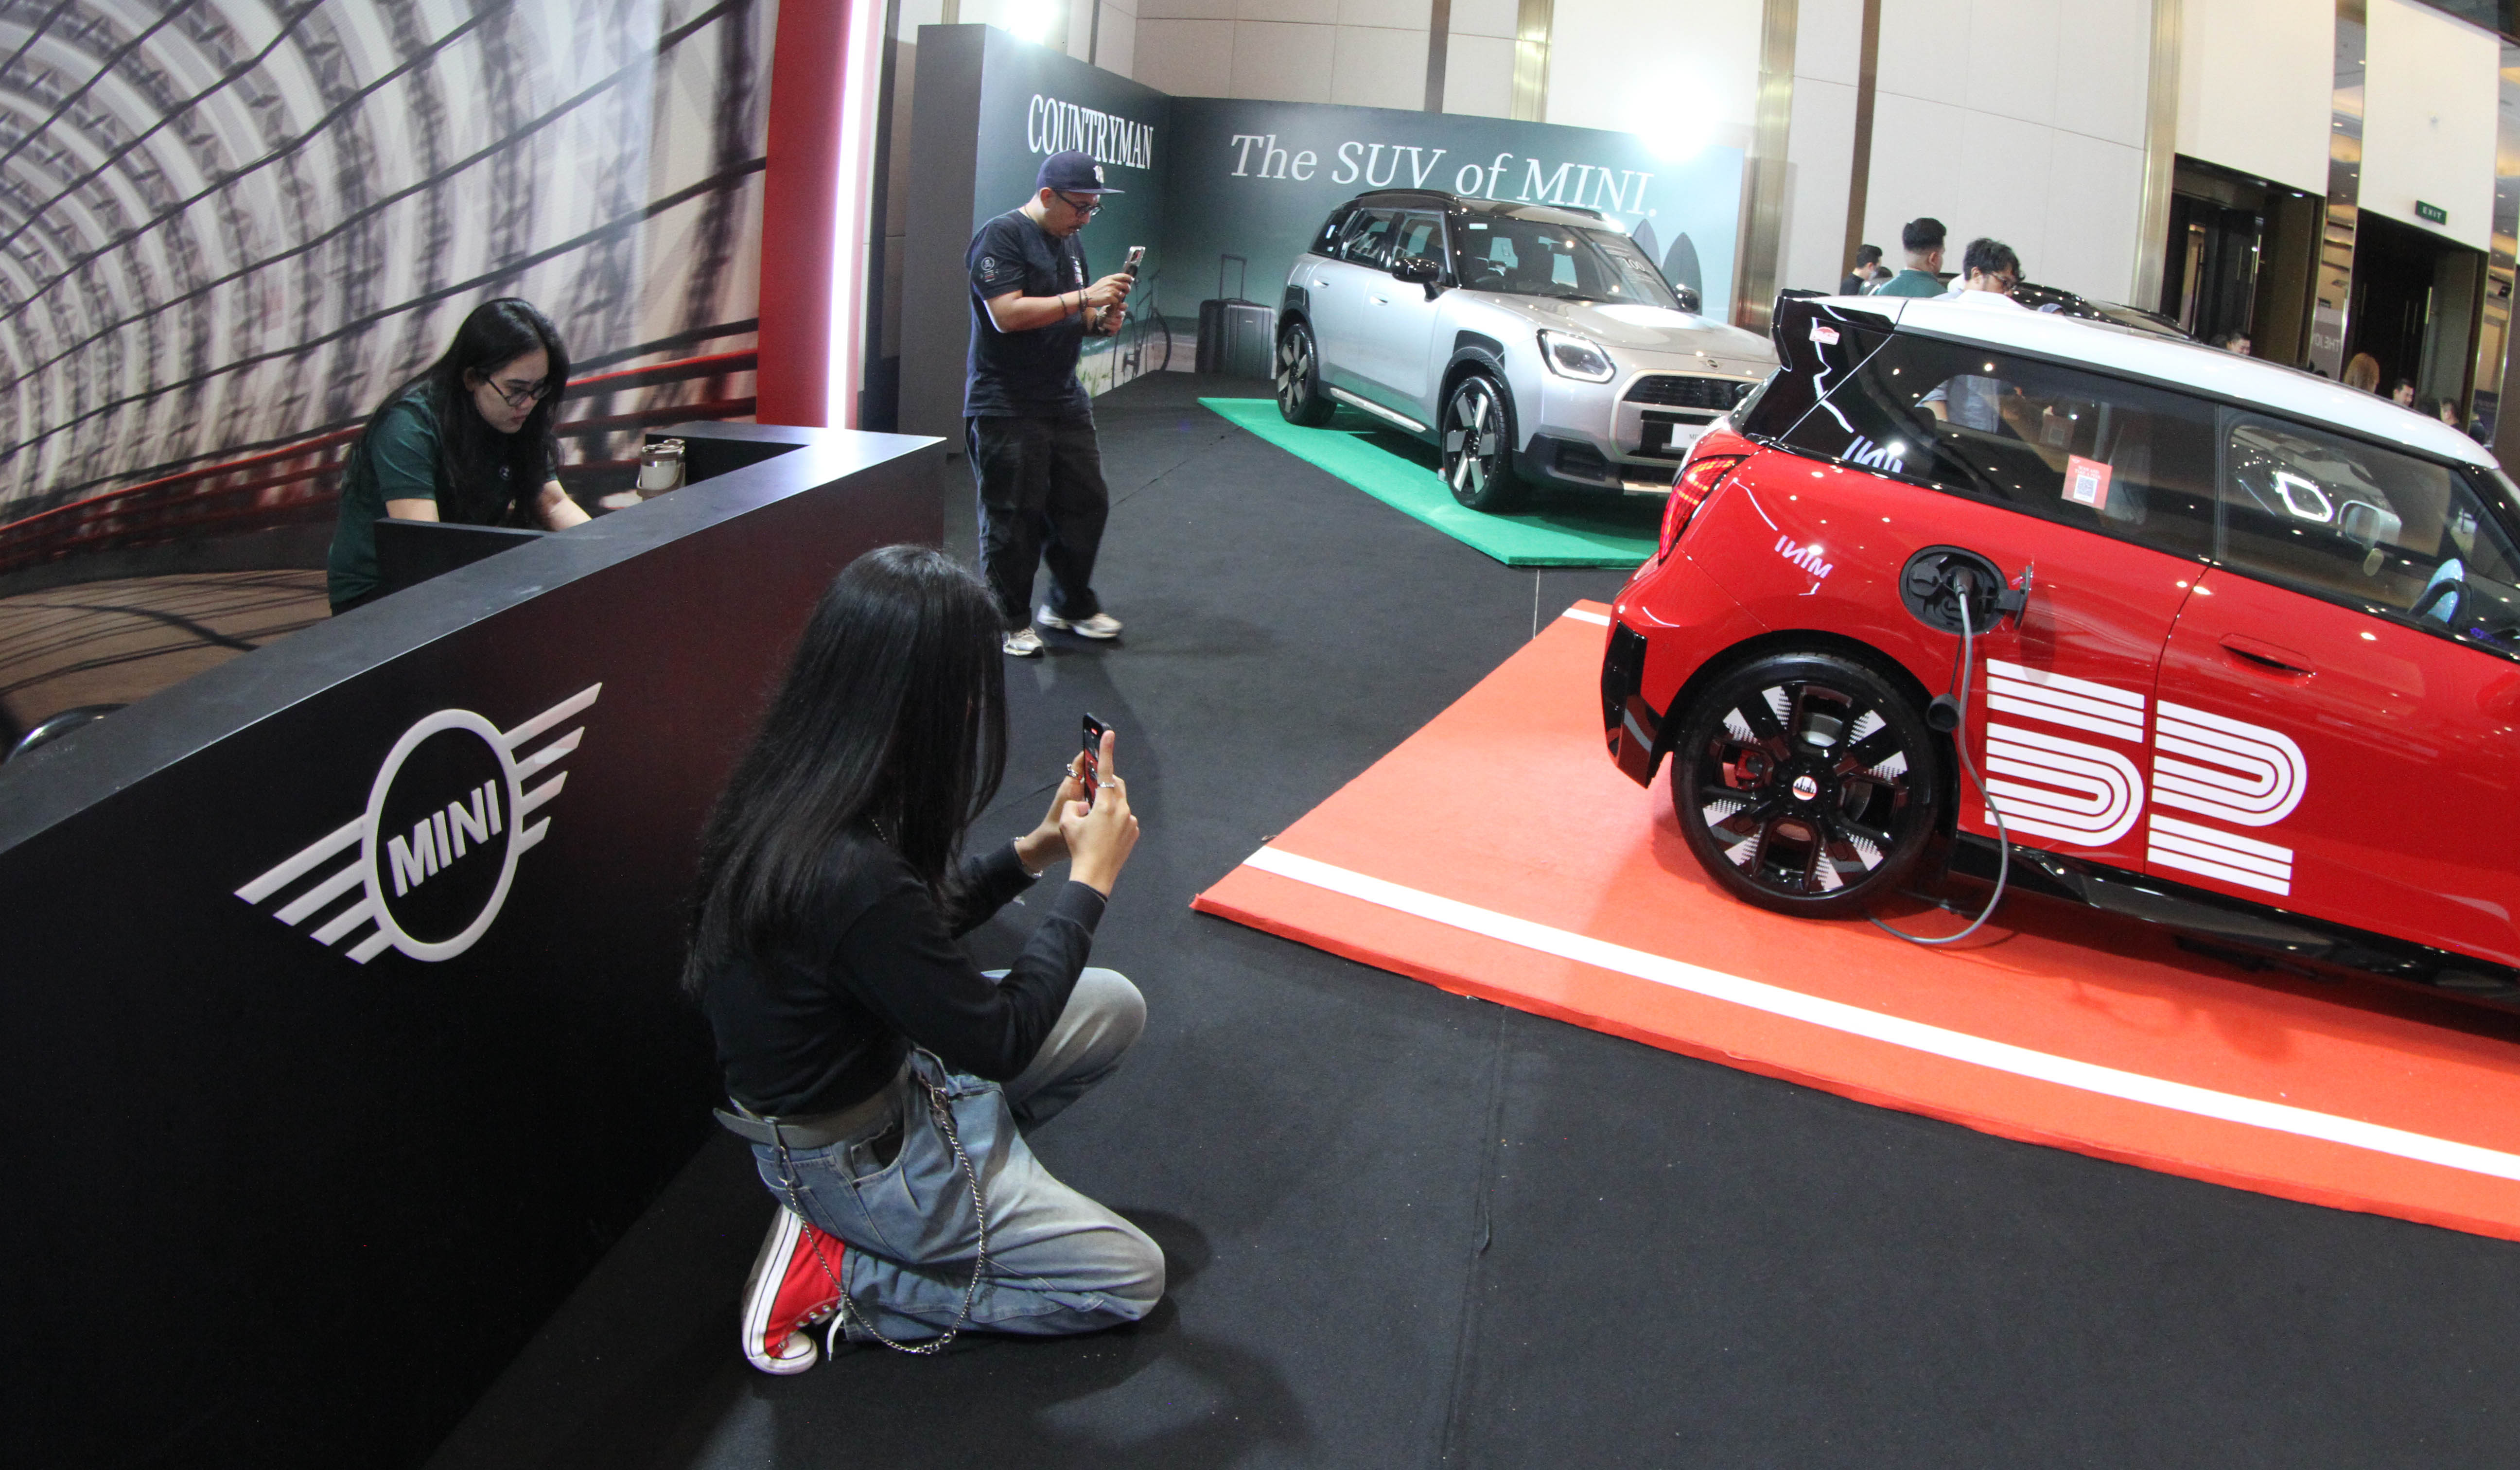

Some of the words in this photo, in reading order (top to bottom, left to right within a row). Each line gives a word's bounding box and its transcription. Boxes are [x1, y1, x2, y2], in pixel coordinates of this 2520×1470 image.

[1028, 94, 1154, 170] COUNTRYMAN
[1231, 134, 1318, 181] The
[1331, 141, 1447, 189] SUV
[1455, 152, 1513, 199] of
[1516, 158, 1657, 217] MINI.
[2422, 206, 2442, 219] EXIT
[1985, 658, 2308, 896] 52
[387, 779, 502, 898] MINI
